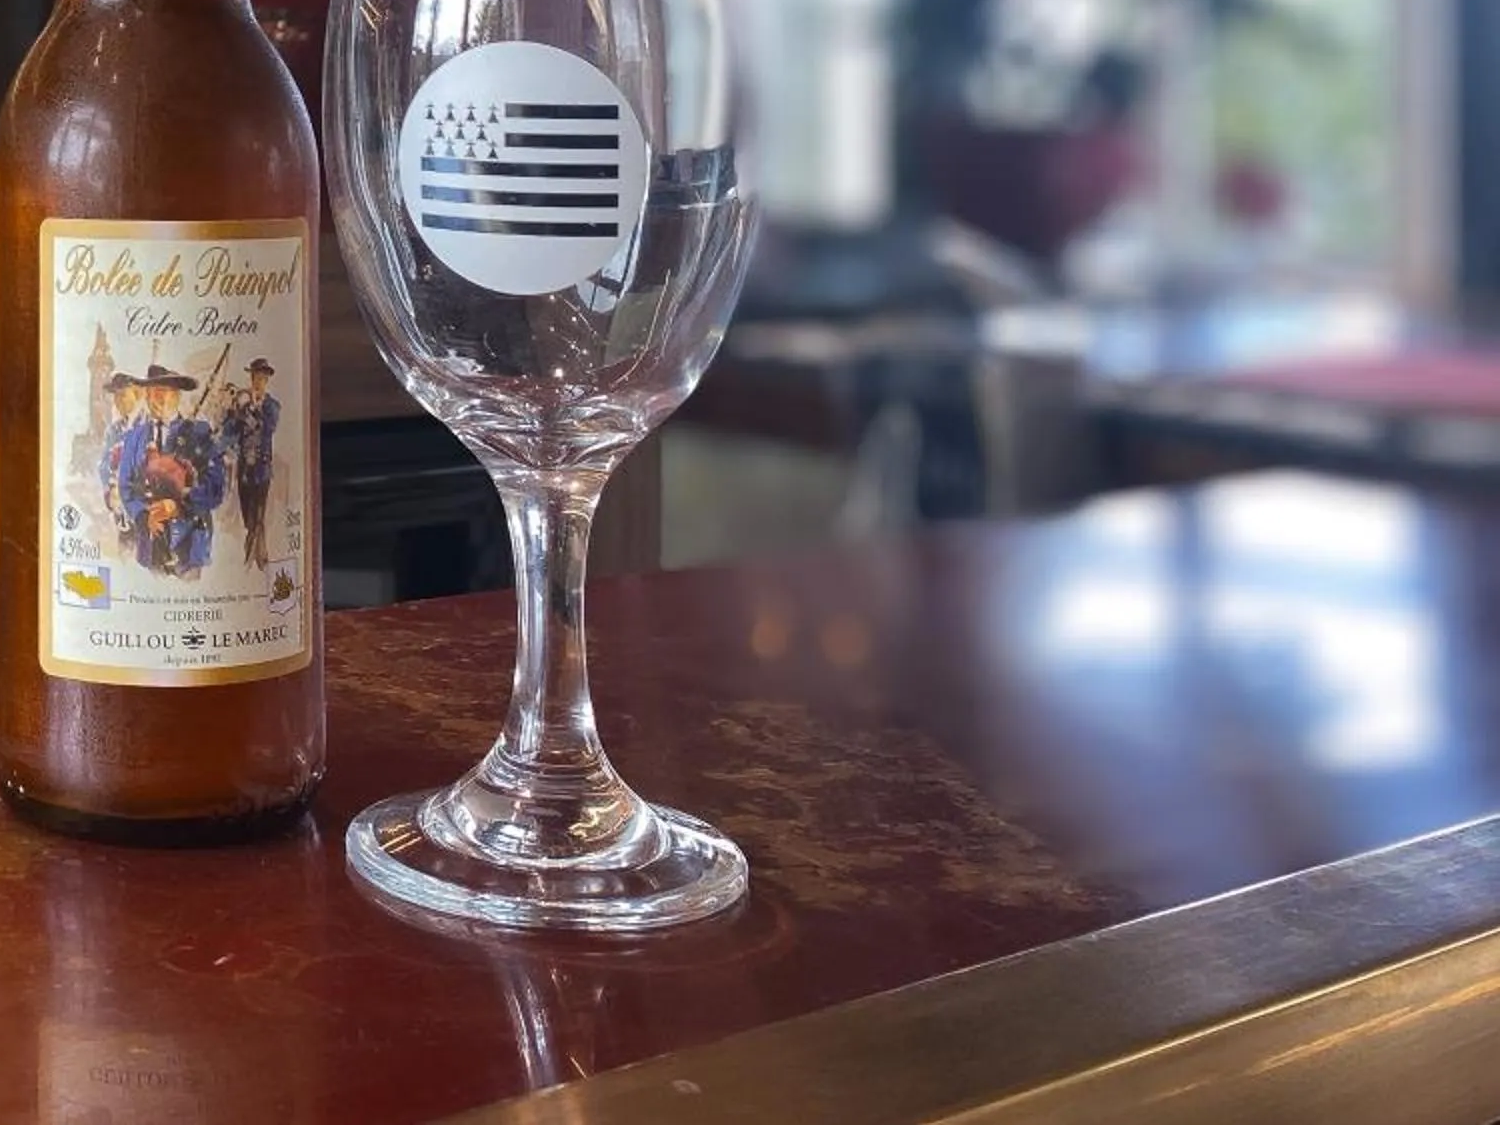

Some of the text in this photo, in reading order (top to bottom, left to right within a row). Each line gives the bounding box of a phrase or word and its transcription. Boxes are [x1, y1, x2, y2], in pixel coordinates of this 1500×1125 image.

[57, 244, 301, 309] Bolée de Paimpol
[125, 305, 260, 338] Cidre Breton
[163, 609, 223, 623] CIDRERIE
[89, 625, 289, 650] GUILLOU LE MAREC
